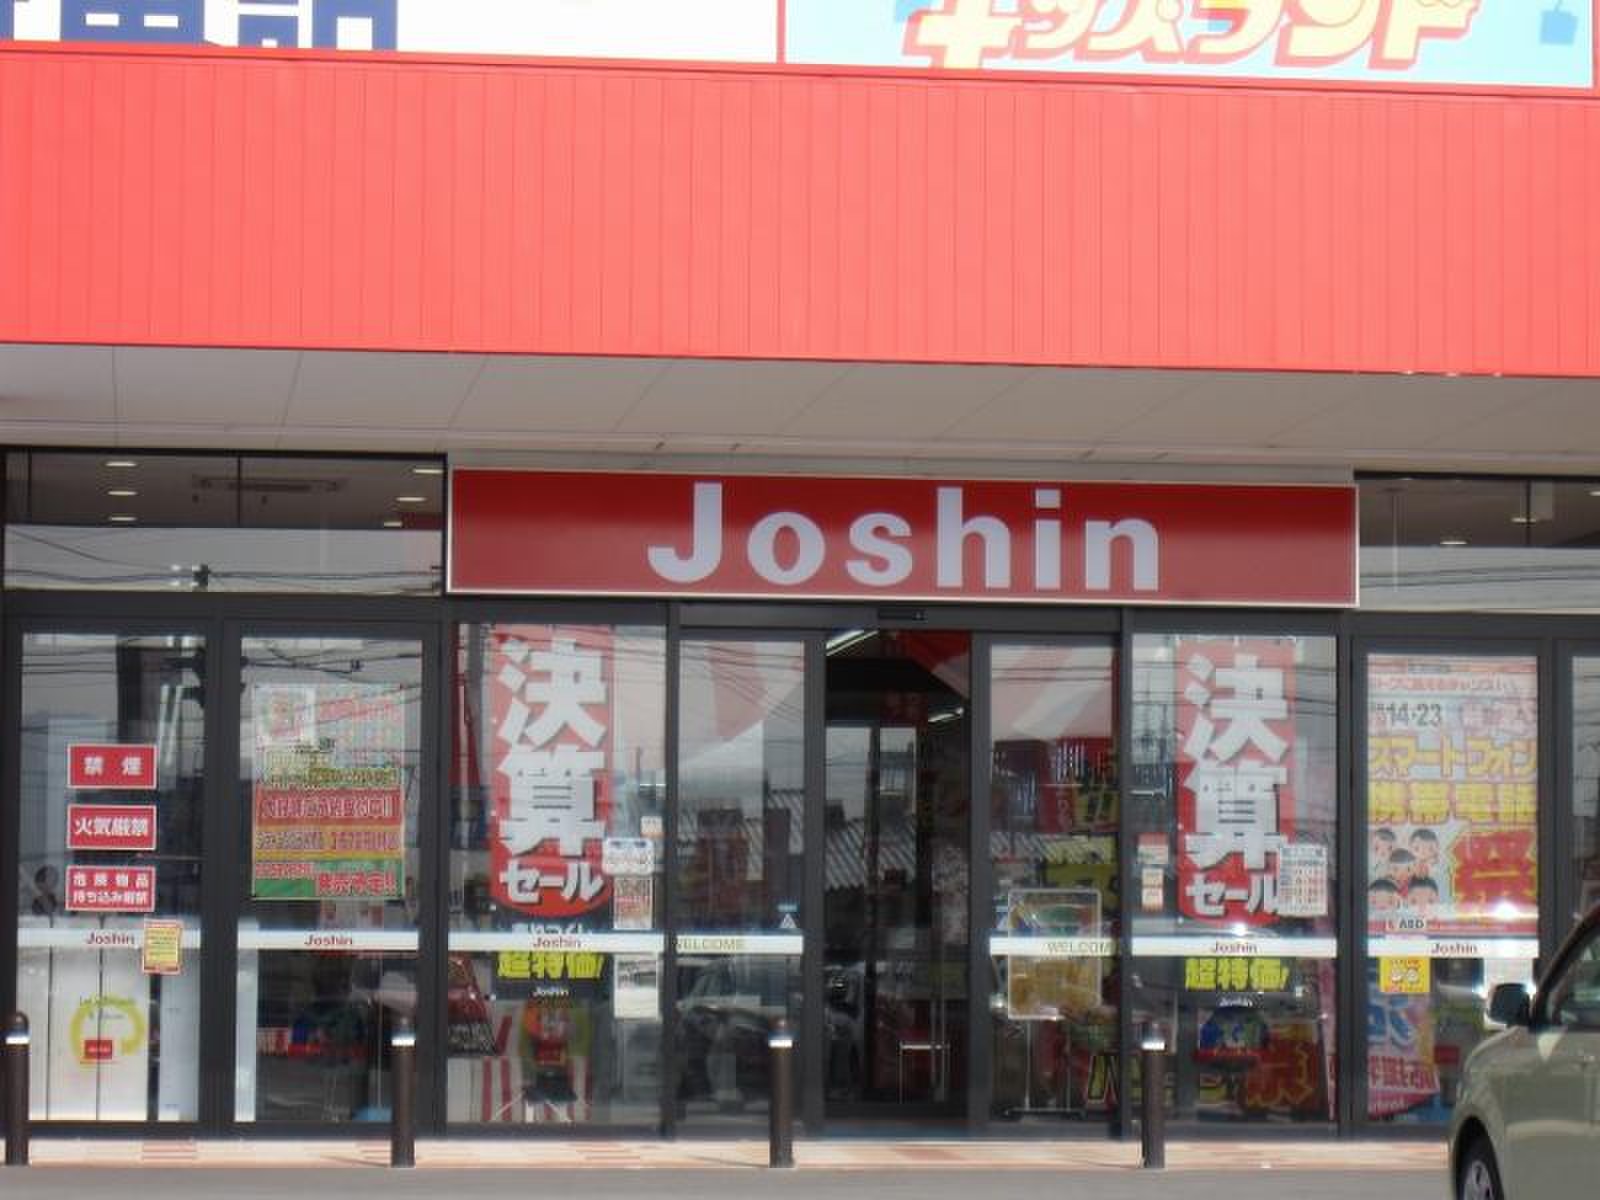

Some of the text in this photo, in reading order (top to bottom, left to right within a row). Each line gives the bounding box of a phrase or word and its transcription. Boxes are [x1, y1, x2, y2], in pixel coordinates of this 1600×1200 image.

[648, 481, 1160, 592] Joshin
[497, 636, 606, 857] 決算
[1184, 654, 1287, 869] 決算
[499, 860, 605, 903] セール
[86, 929, 135, 946] Joshin
[304, 933, 354, 948] Joshin
[532, 935, 582, 950] Joshin
[1211, 940, 1259, 954] Joshin
[1430, 942, 1479, 956] Joshin
